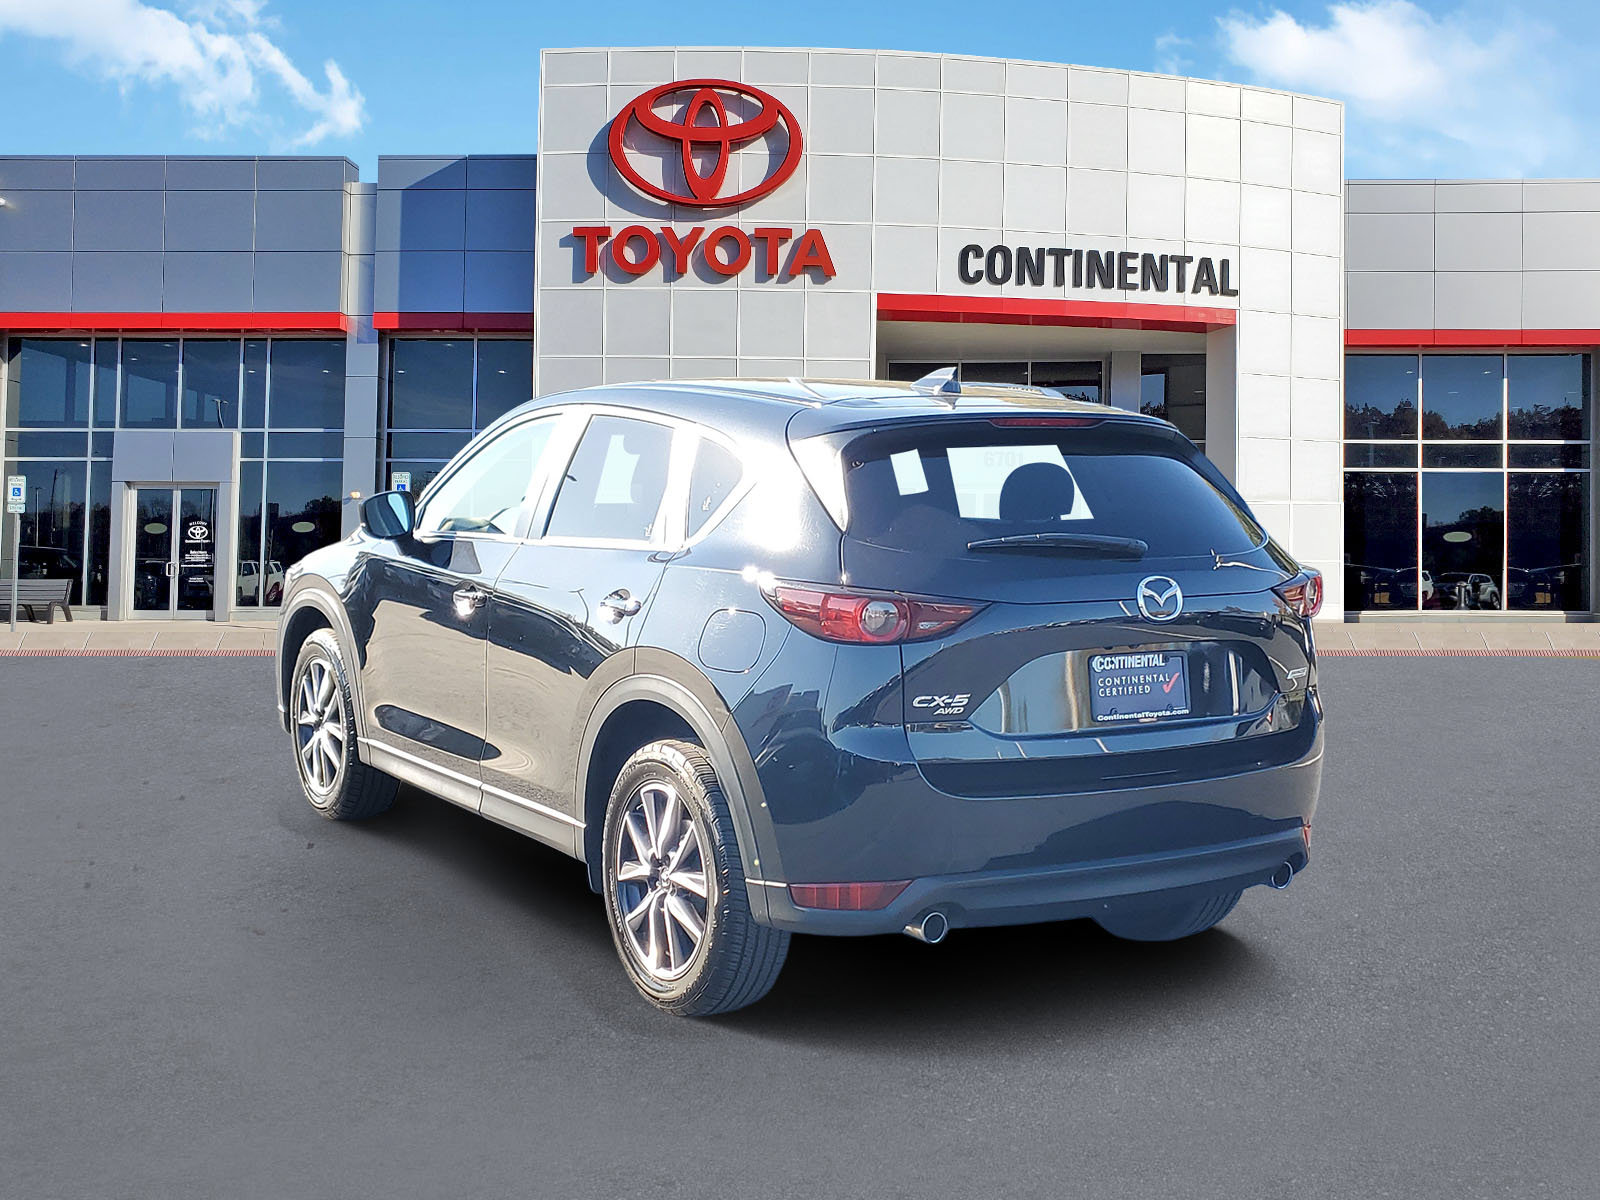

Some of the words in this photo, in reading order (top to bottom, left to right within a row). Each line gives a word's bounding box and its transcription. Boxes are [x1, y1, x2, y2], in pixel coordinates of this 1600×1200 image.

[572, 225, 837, 276] TOYOTA
[958, 244, 1239, 297] CONTINENTAL
[1092, 654, 1166, 673] CONTINENTAL
[1097, 673, 1170, 687] CONTINENTAL
[1098, 685, 1151, 697] CERTIFIED
[912, 693, 971, 708] CX-5
[933, 707, 964, 715] AWD
[1097, 708, 1190, 721] ContinentalToyota.com
